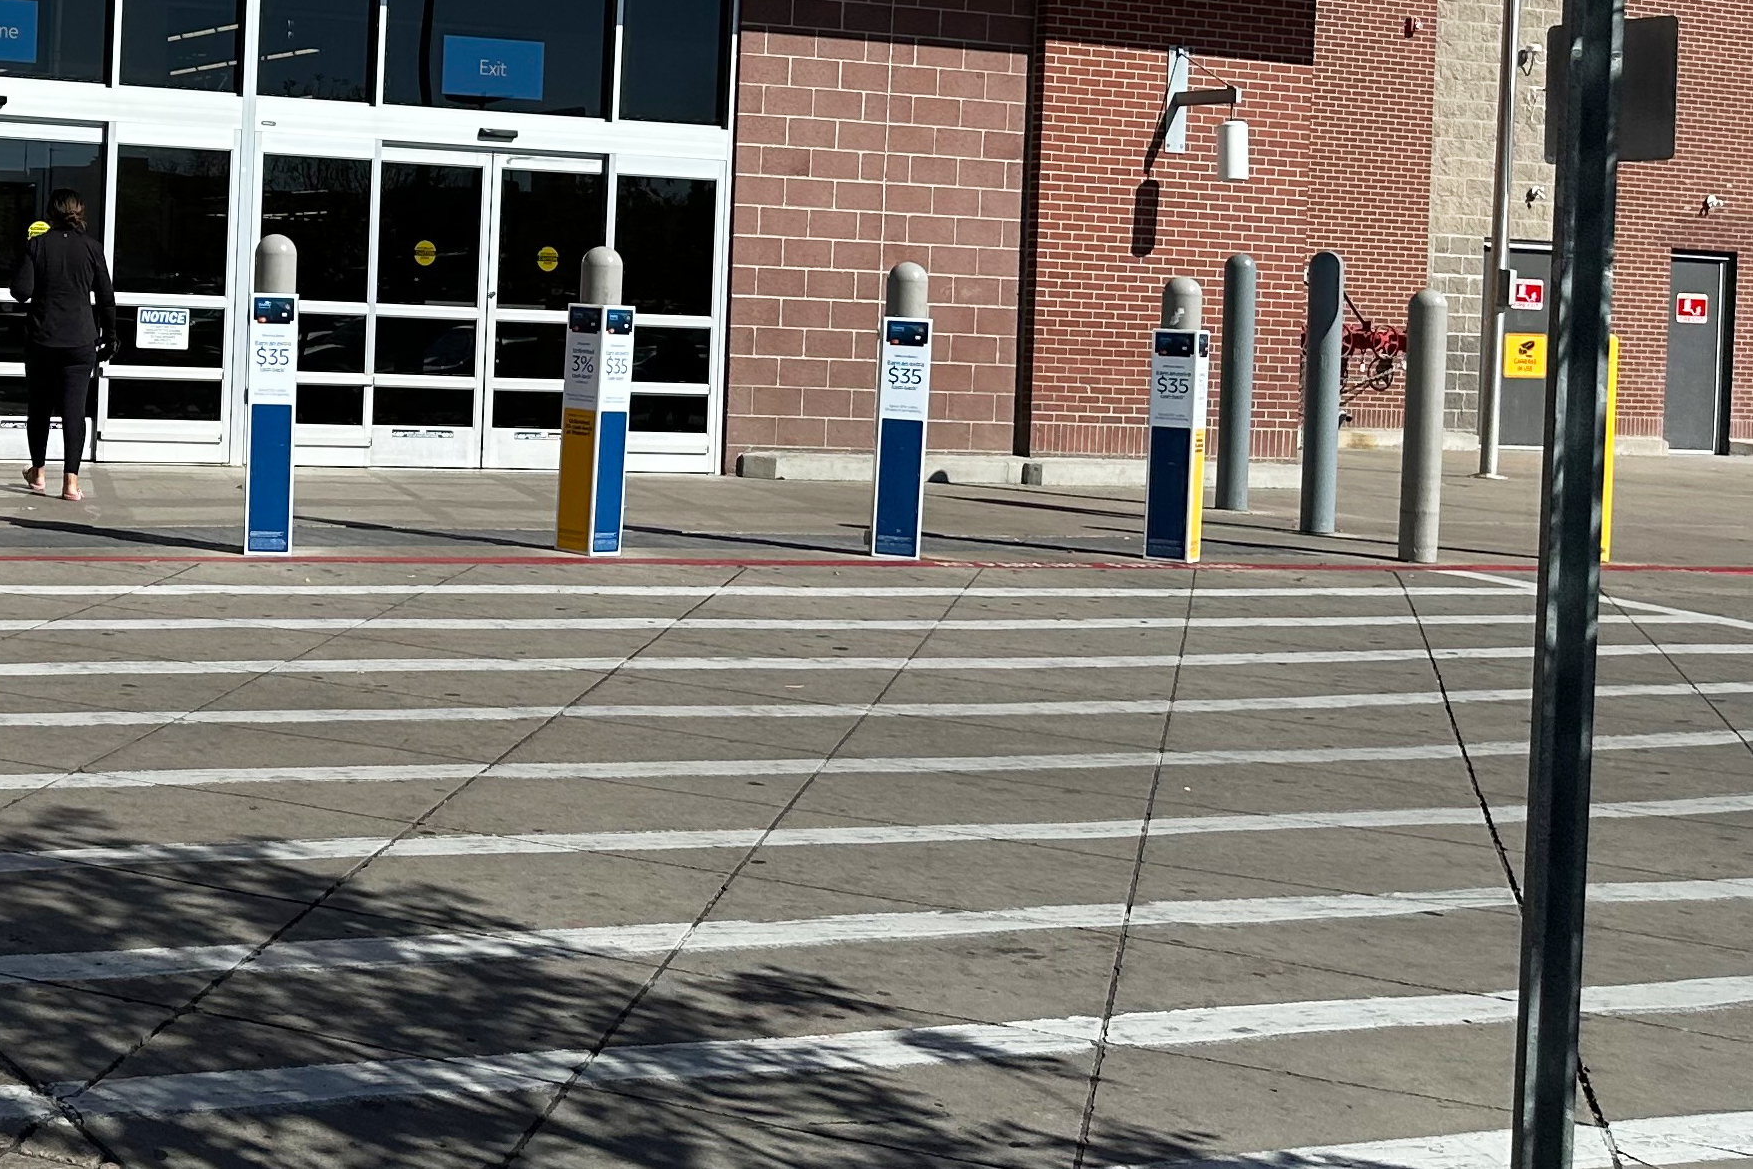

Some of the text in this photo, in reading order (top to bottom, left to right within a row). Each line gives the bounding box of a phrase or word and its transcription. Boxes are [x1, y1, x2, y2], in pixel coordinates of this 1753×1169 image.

[478, 57, 507, 79] Exit
[140, 310, 186, 324] NOTICE
[256, 346, 289, 367] $35
[572, 355, 594, 374] 3%
[606, 356, 628, 376] $35
[888, 366, 922, 384] $35
[1156, 375, 1189, 394] $35
